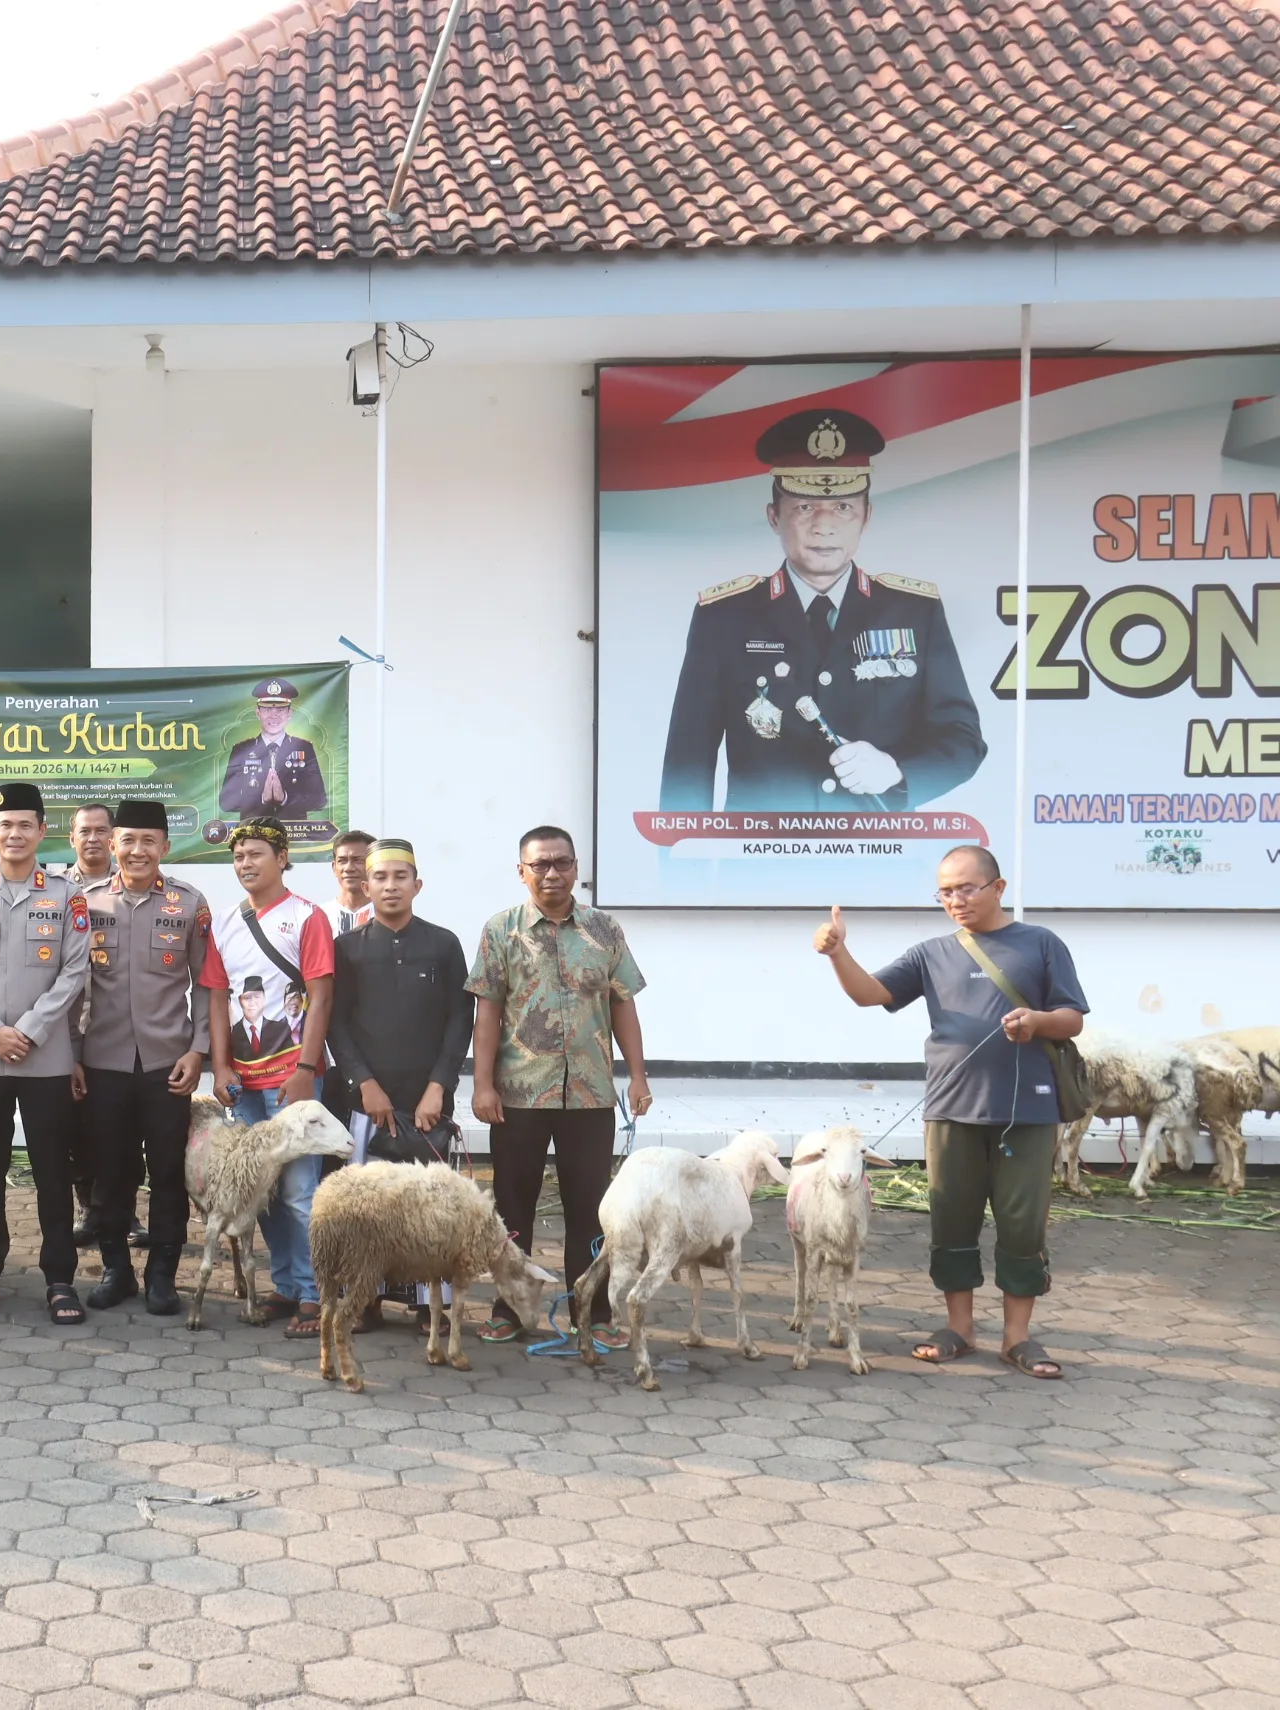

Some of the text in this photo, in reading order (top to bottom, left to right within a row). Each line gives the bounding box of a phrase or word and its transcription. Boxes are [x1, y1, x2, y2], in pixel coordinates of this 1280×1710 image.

[5, 696, 99, 711] Penyerahan
[59, 711, 206, 755] Kurban
[32, 763, 63, 774] 2026
[66, 763, 78, 773] M
[80, 763, 86, 775] /
[89, 763, 117, 773] 1447
[120, 763, 130, 773] H
[43, 783, 89, 791] kebersamaan,
[56, 792, 70, 800] bagi
[71, 792, 109, 800] masyarakat
[1035, 794, 1124, 823] RAMAH
[1128, 794, 1256, 823] TERHADAP
[166, 813, 185, 821] erkah
[651, 817, 971, 832] IRJEN POL. Drs. NANANG AVIANTO, M.Si.
[1144, 829, 1204, 839] KOTAKU
[743, 843, 902, 854] KAPOLDA JAWA TIMUR
[28, 911, 62, 920] POLRI
[90, 917, 116, 927] DIDID
[155, 917, 186, 929] POLRI
